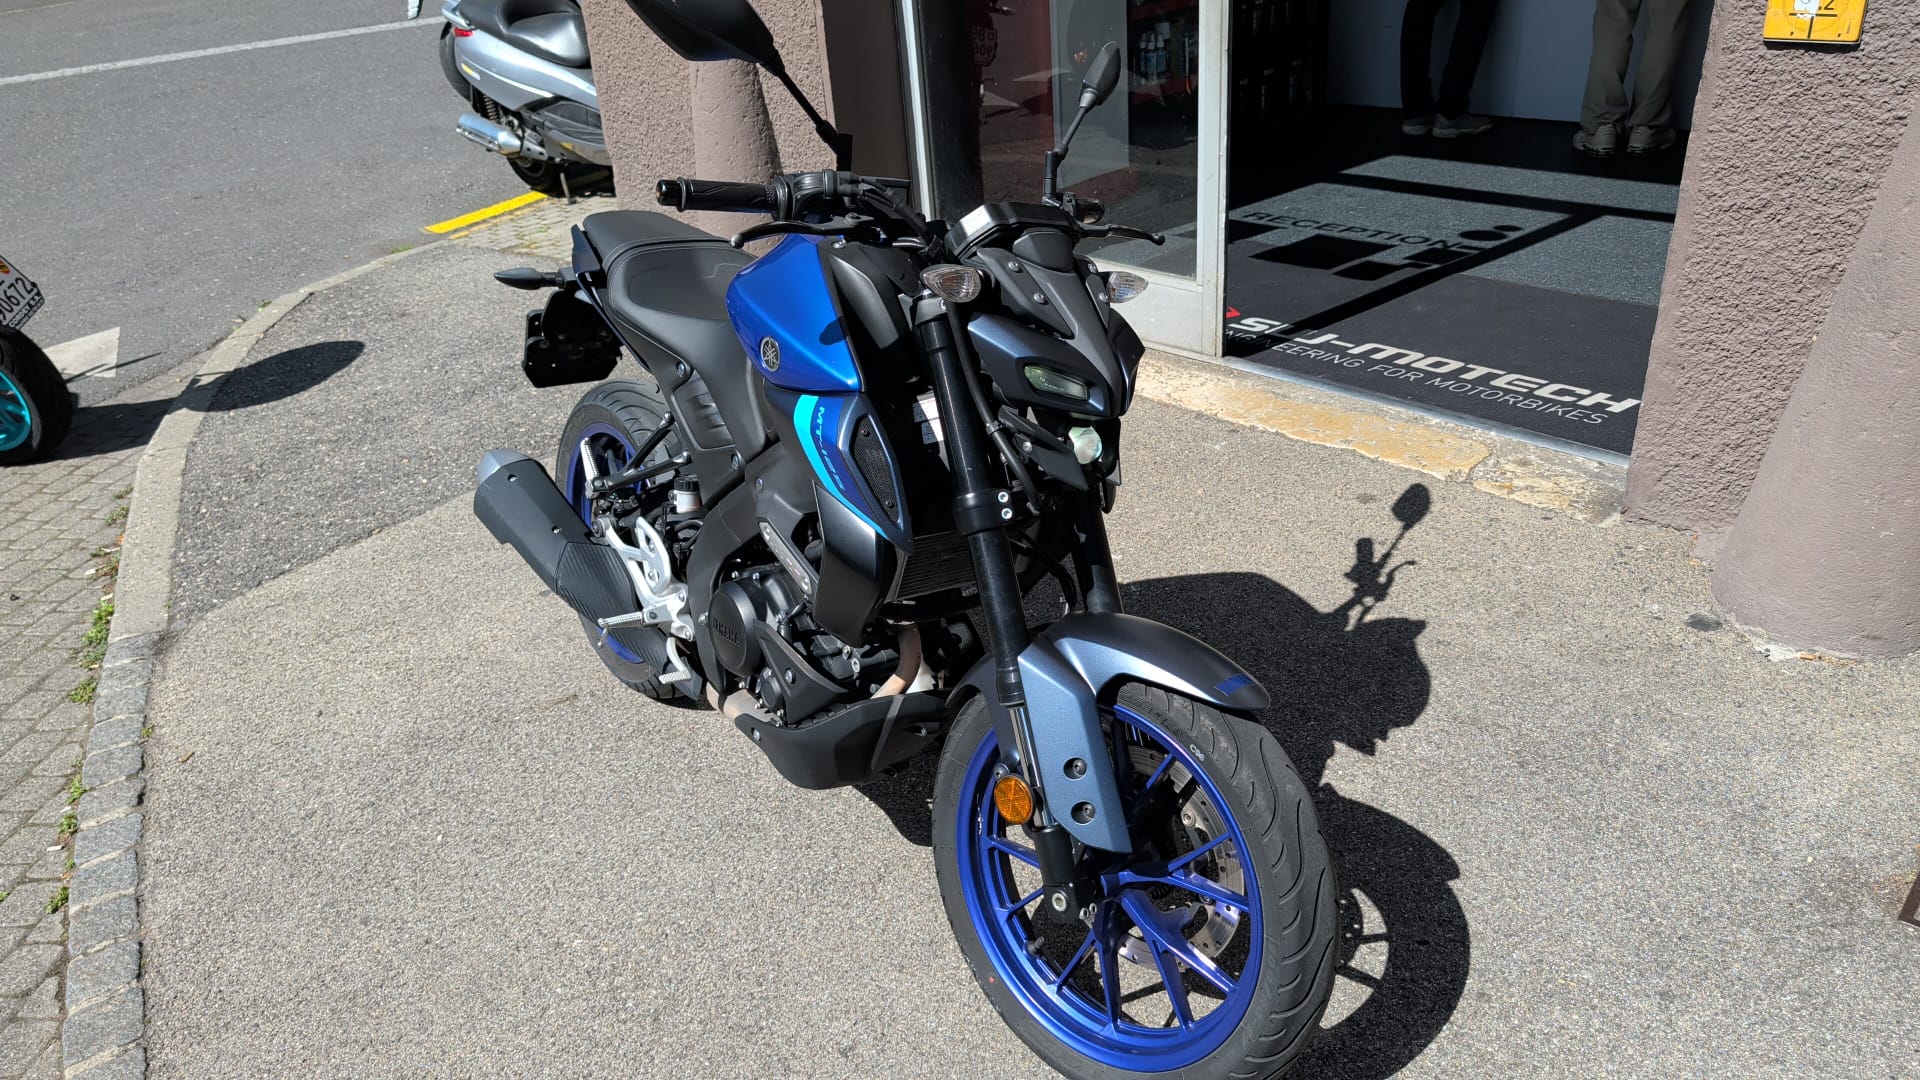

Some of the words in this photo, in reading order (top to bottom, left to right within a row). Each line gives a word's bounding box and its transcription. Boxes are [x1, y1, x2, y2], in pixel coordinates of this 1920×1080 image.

[1242, 211, 1460, 250] RECEPTION
[1367, 365, 1424, 382] FOR
[1425, 377, 1609, 425] MOTORBIKES
